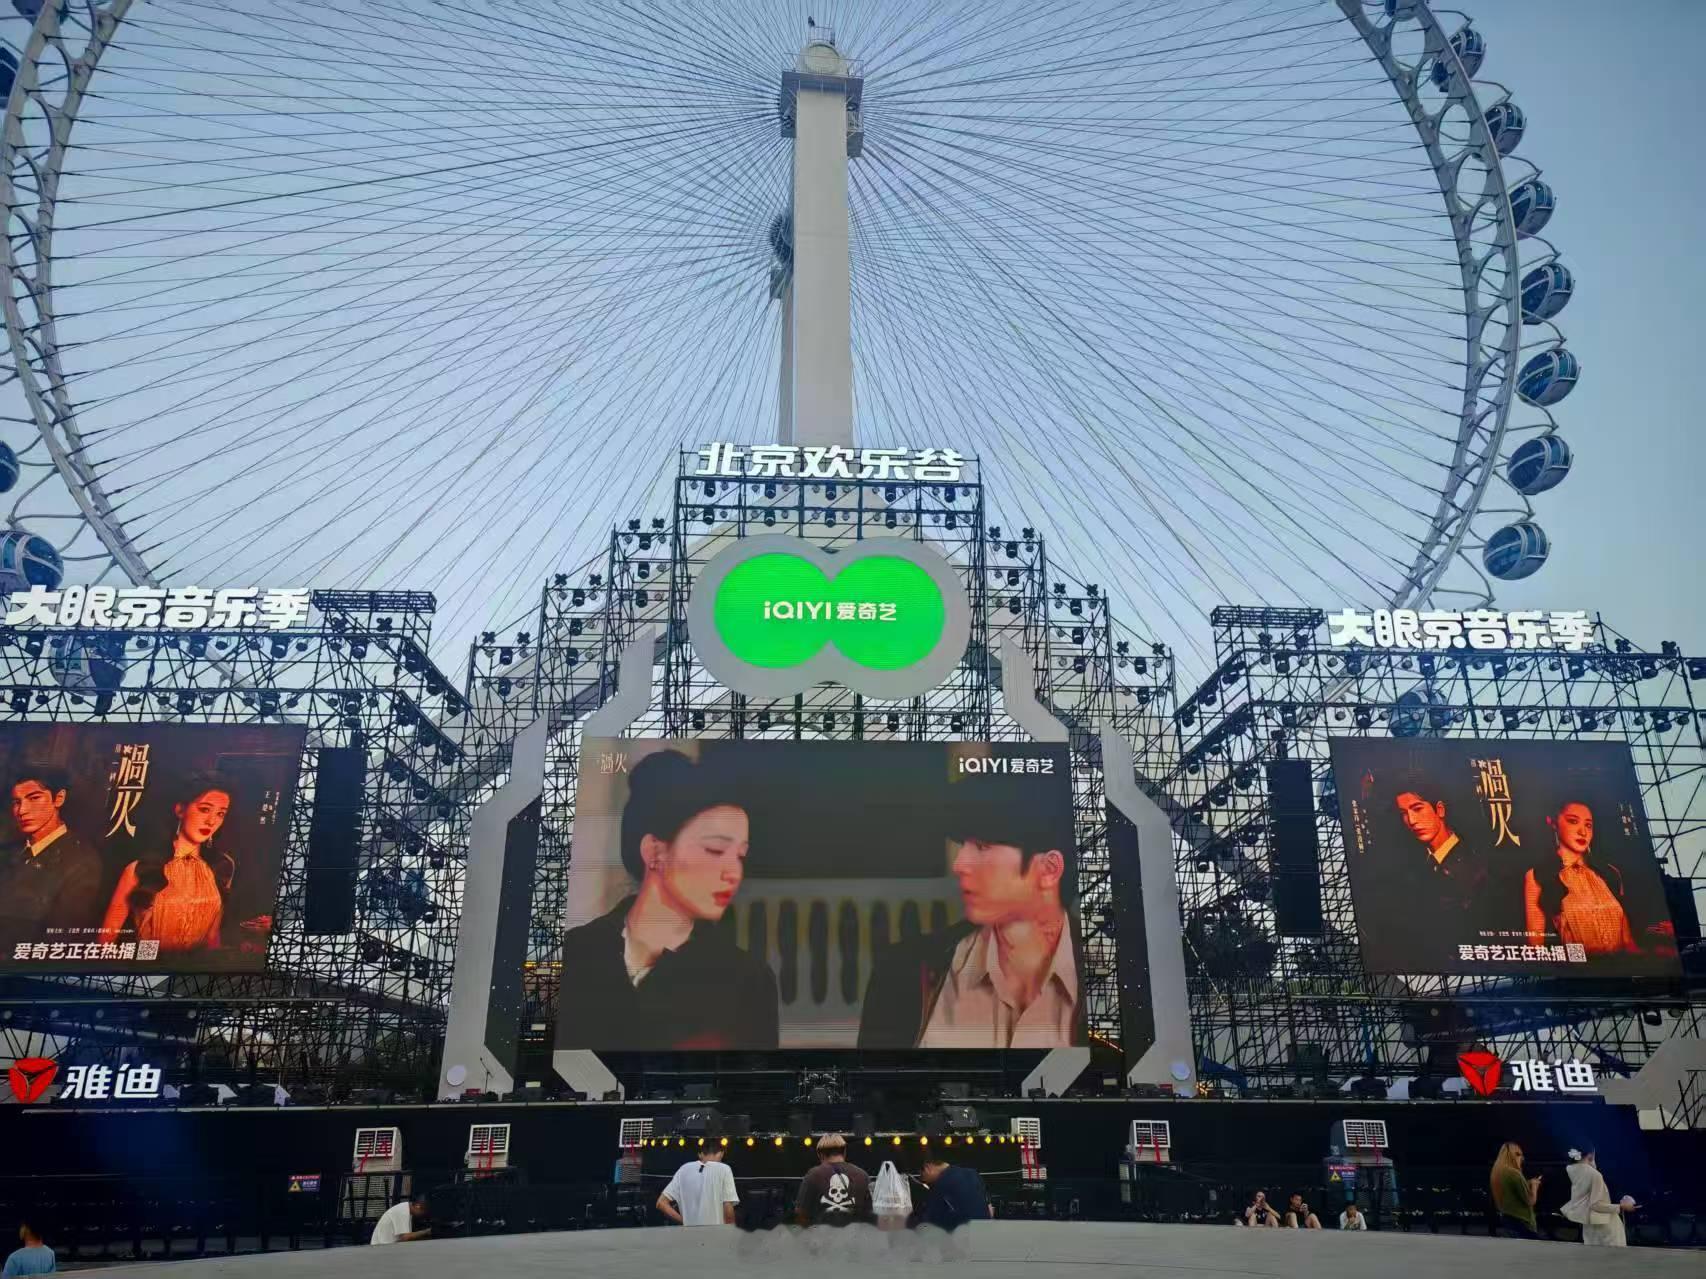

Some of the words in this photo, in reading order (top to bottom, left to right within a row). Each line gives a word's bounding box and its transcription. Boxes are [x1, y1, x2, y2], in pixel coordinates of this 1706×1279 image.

[695, 442, 964, 481] 北京欢乐谷
[6, 584, 311, 629] 大眼京音乐季
[764, 601, 831, 620] iQIYI
[836, 602, 896, 621] 爱奇艺
[1328, 608, 1595, 650] 大眼京音乐季
[959, 757, 1007, 773] iQIYI
[1010, 758, 1054, 774] 爱奇艺
[13, 940, 137, 961] 爱奇艺正在热播
[1458, 944, 1567, 962] 爱奇艺正在热播
[60, 1063, 162, 1099] 雅迪
[1509, 1058, 1598, 1092] 雅迪
